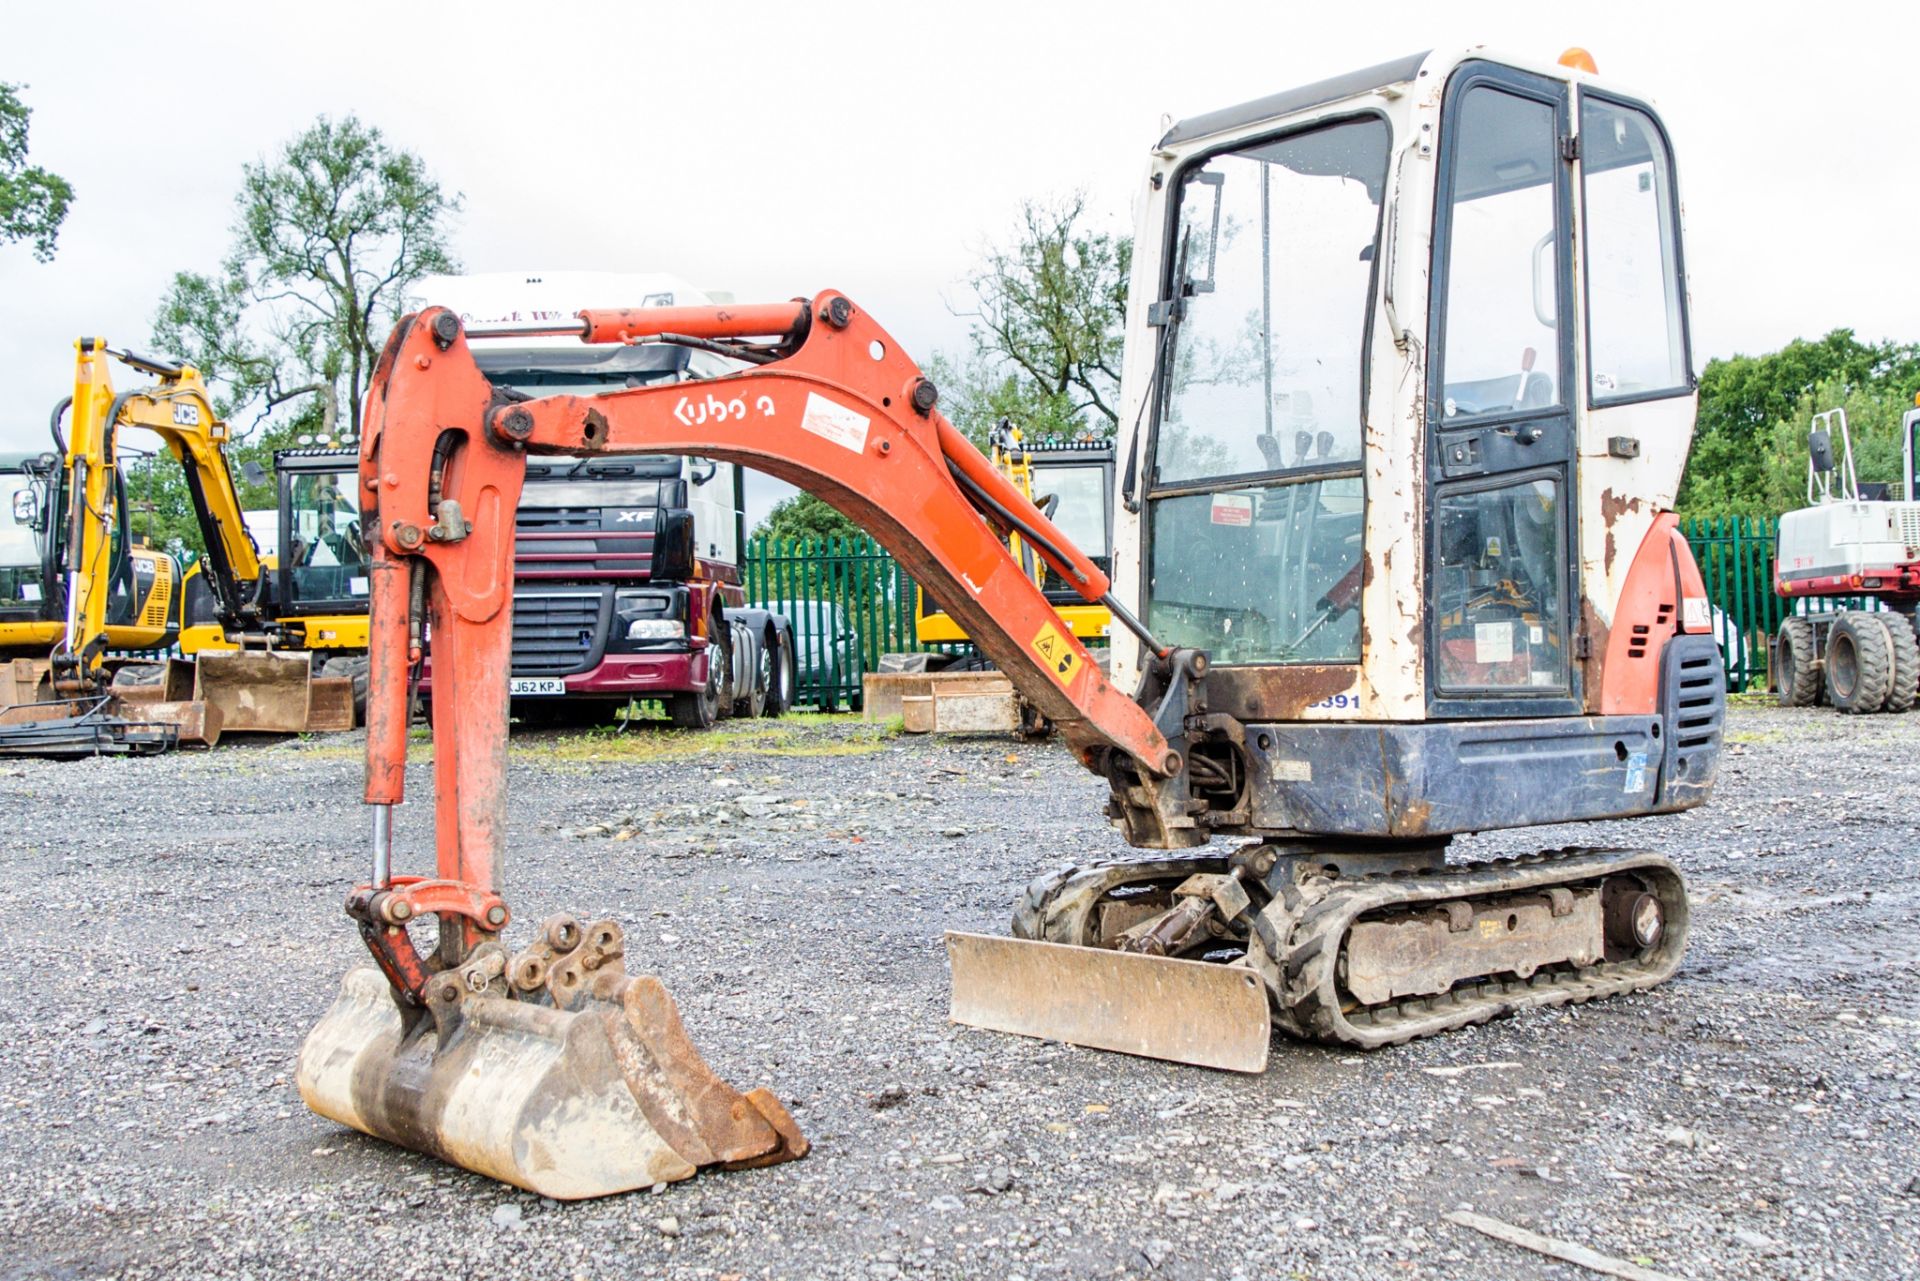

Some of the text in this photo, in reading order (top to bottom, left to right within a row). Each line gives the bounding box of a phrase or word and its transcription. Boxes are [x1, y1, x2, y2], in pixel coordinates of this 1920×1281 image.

[174, 402, 198, 426] JCB
[673, 393, 775, 426] Kuboa
[616, 511, 655, 522] XF
[135, 559, 155, 574] JCB
[540, 681, 563, 692] KPJ
[1306, 694, 1360, 709] 391
